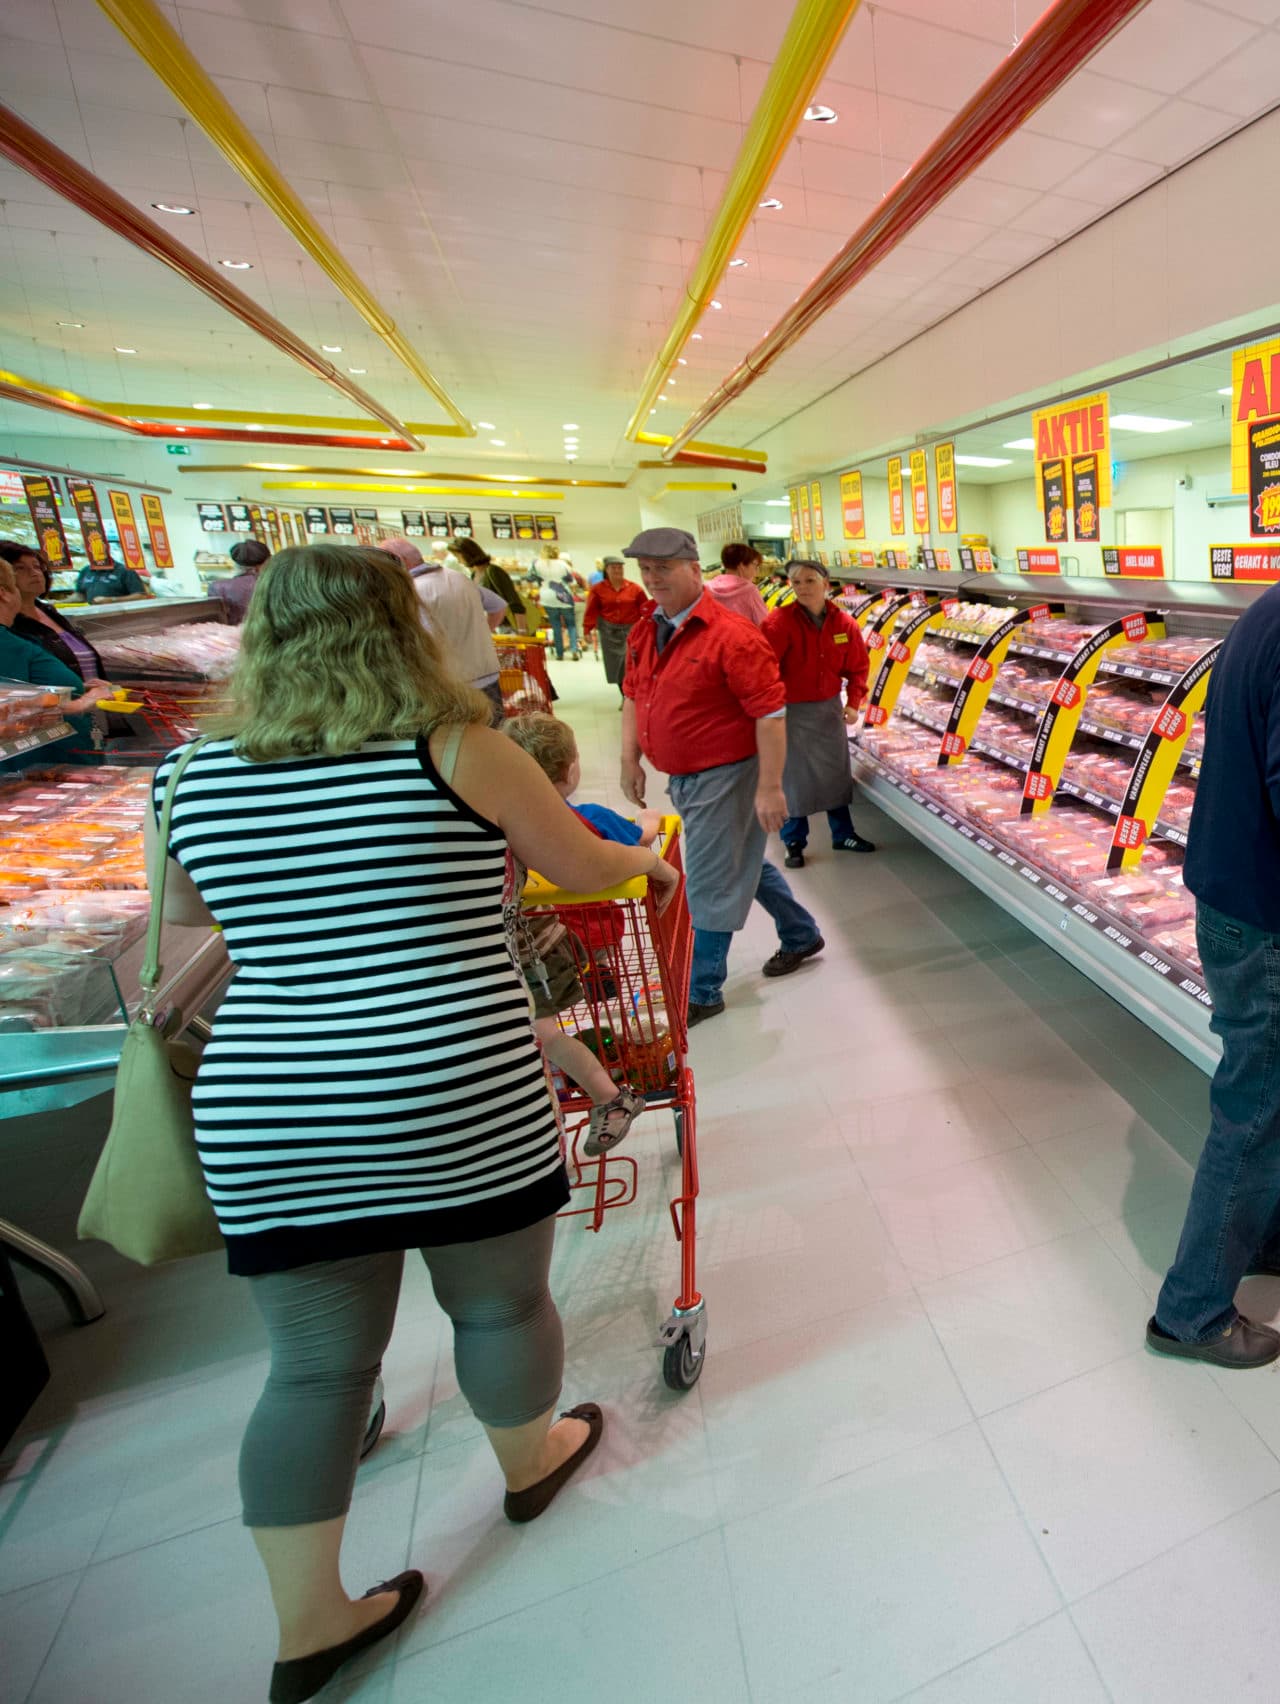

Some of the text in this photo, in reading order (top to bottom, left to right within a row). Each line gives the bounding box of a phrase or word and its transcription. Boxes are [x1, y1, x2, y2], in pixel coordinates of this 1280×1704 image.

[1037, 403, 1105, 461] AKTIE
[1139, 555, 1154, 567] KLAAR
[1213, 549, 1232, 562] BESTE
[1235, 555, 1261, 569] GEHAKT
[1262, 557, 1269, 569] &
[1213, 563, 1232, 577] VERS!
[1125, 617, 1144, 628] BESTE
[1128, 627, 1145, 638] VERS!
[1074, 648, 1091, 670] GEHAKT
[1094, 630, 1111, 647] WORST
[1057, 681, 1069, 701] BESTE
[1065, 685, 1077, 704] VERS!
[1159, 707, 1174, 732] BESTE
[1168, 712, 1183, 737] VERS!
[1035, 739, 1045, 763] GEHAKT
[1129, 749, 1152, 800] VARKENSVLEES
[1029, 776, 1037, 796] BESTE
[1037, 776, 1047, 797] VERS!
[1119, 818, 1130, 844] BESTE
[1128, 822, 1141, 845] VERS!
[1139, 951, 1171, 974] ALTIJD LAAG
[1179, 979, 1201, 996] ALTIJD
